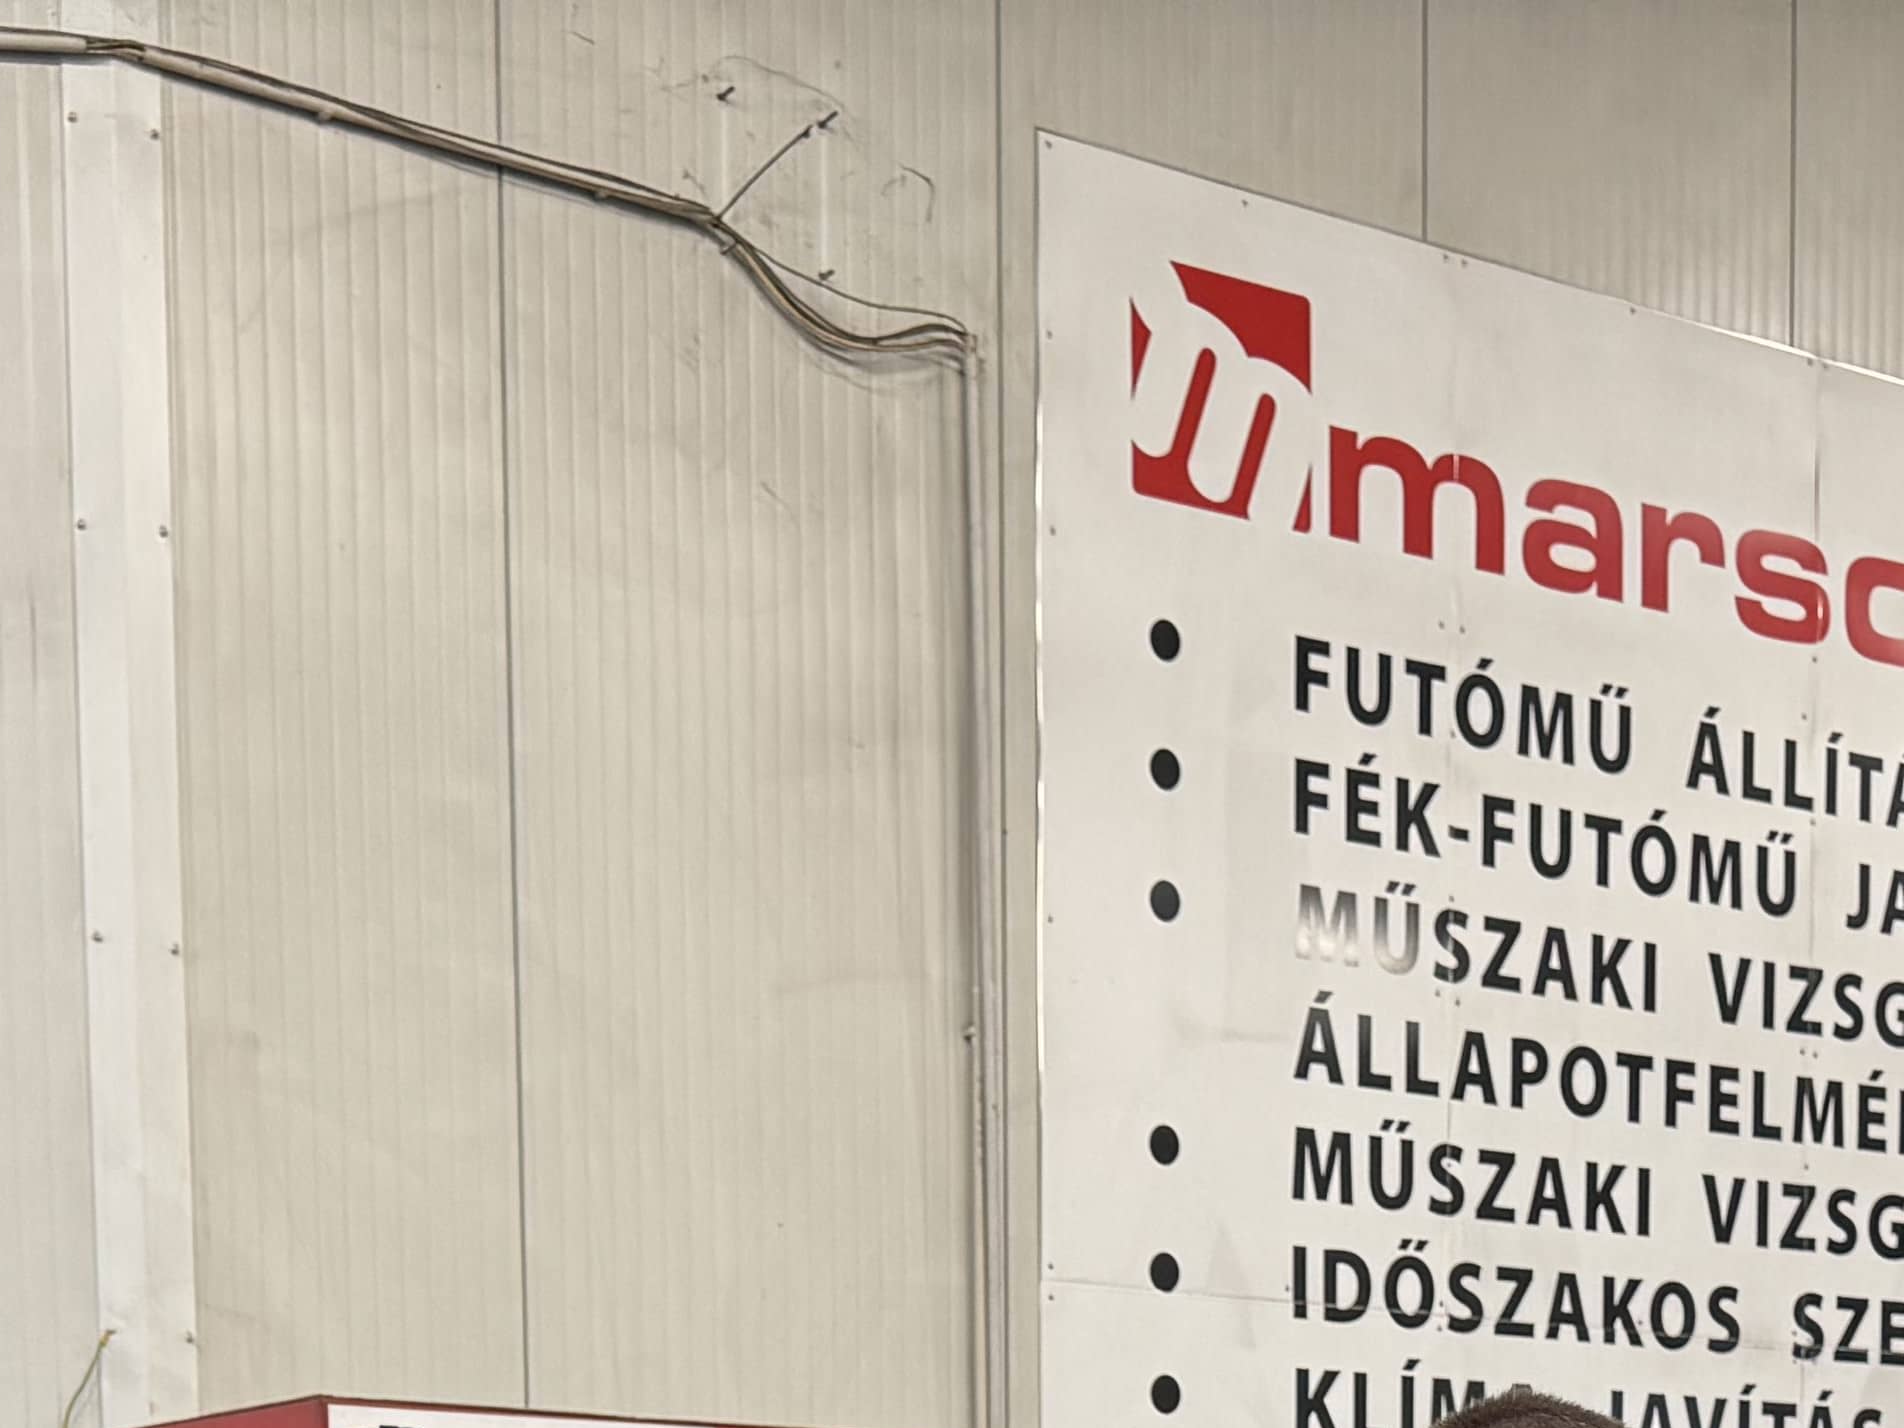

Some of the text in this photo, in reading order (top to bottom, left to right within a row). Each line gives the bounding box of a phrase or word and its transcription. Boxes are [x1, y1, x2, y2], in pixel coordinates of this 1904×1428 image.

[1296, 635, 1632, 774] FUTÓMŰ
[1295, 753, 1796, 917] FÉK-FUTÓMŰ
[1297, 881, 1657, 1013] MŰSZAKI
[1293, 1119, 1651, 1237] MŰSZAKI
[1293, 1239, 1741, 1354] IDŐSZAKOS
